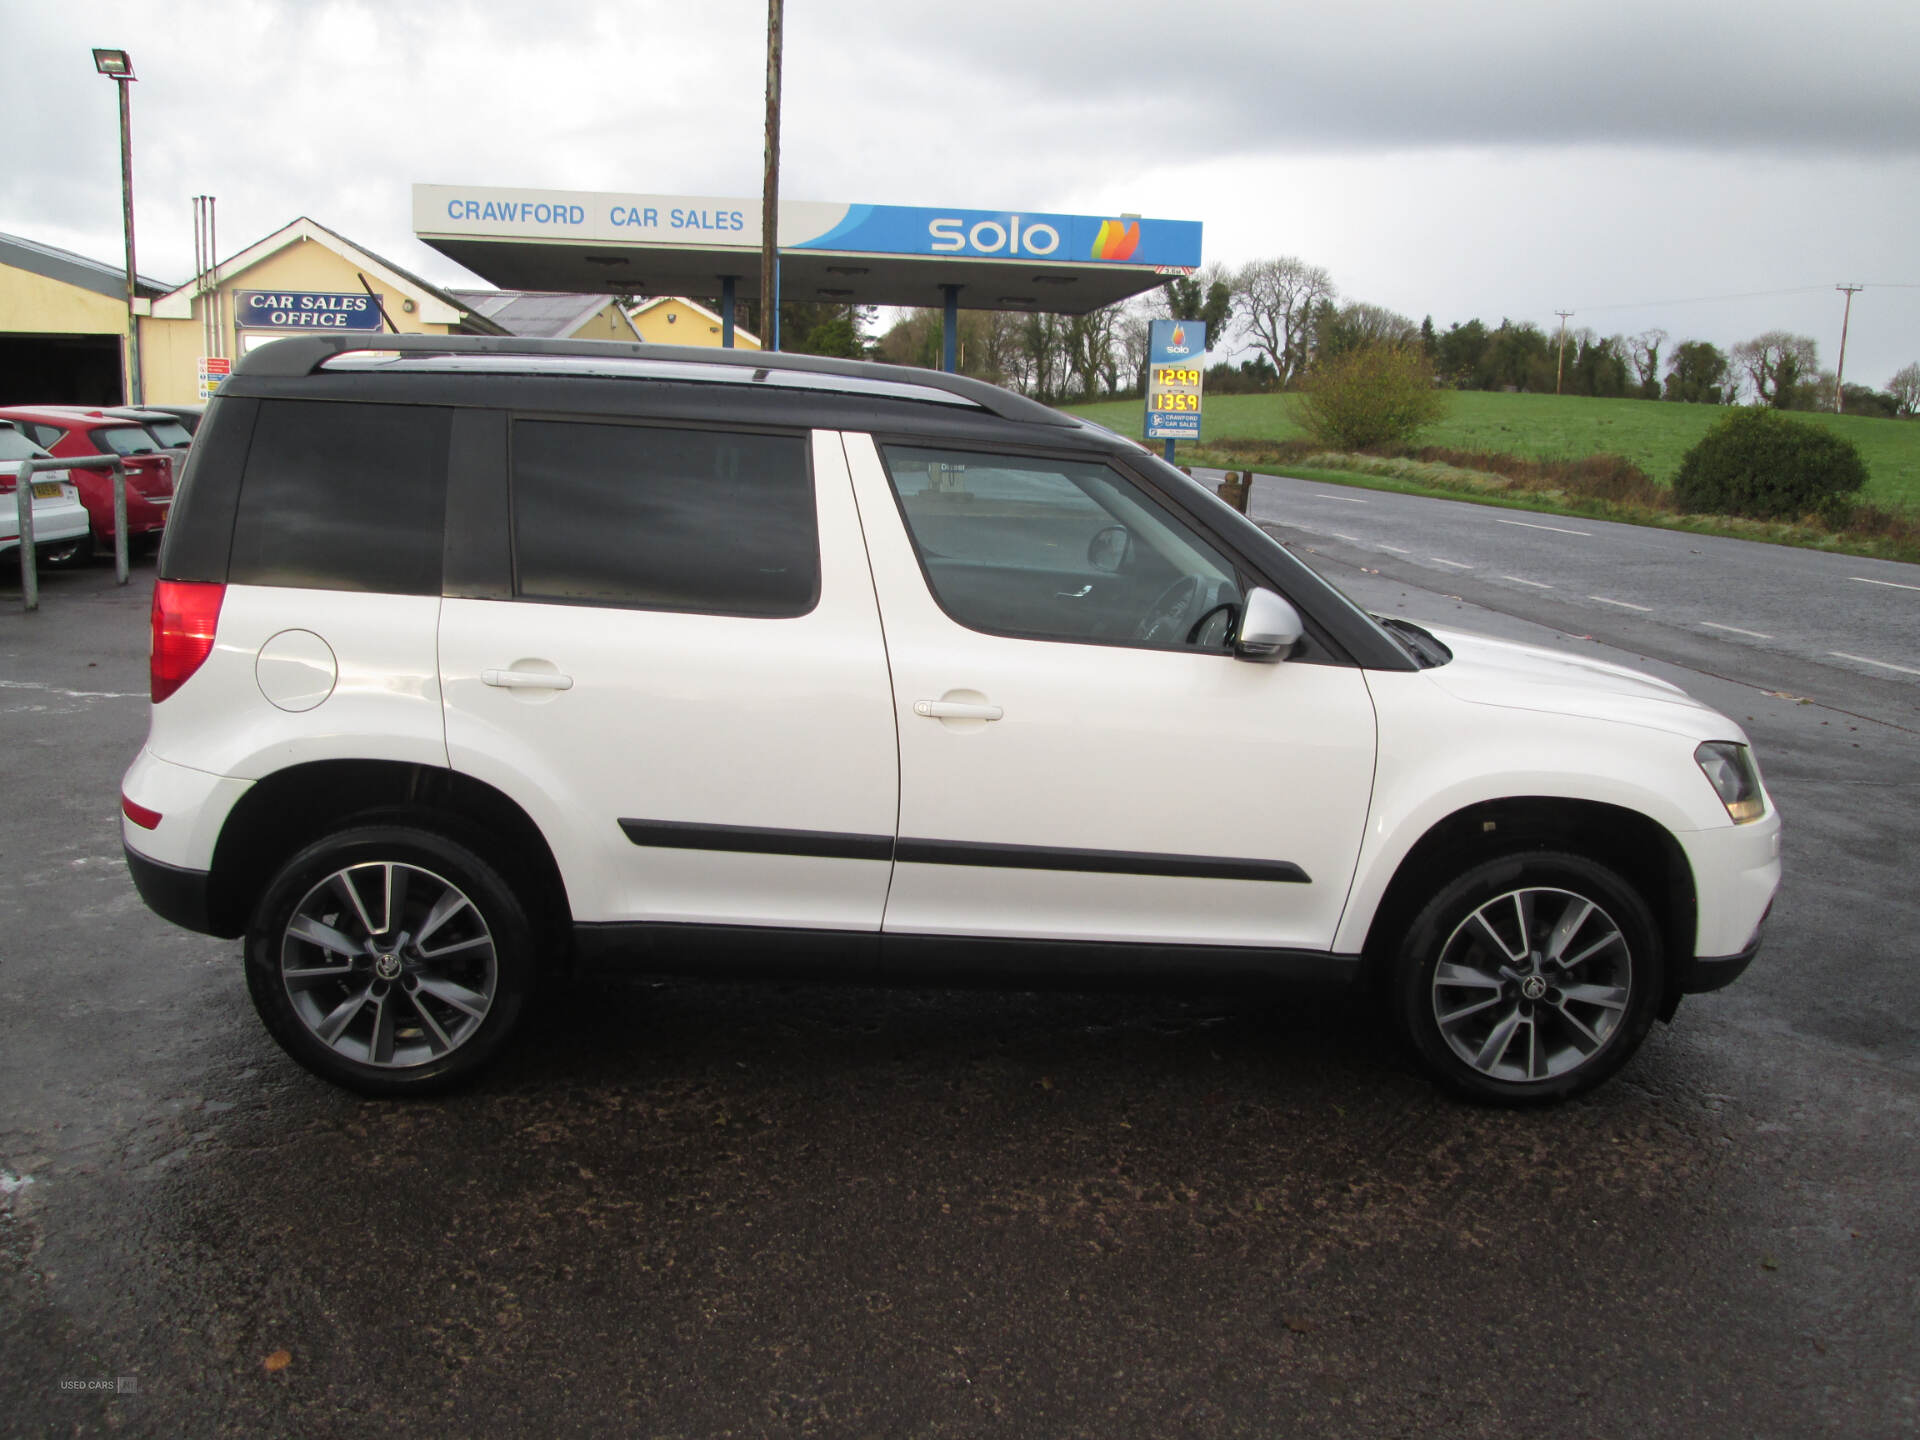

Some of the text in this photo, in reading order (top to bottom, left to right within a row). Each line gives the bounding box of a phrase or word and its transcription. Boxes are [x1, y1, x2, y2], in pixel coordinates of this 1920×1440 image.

[447, 200, 744, 231] CRAWFORD CAR SALES
[928, 215, 1060, 255] solo
[250, 295, 367, 311] CAR SALES
[271, 311, 348, 327] OFFICE
[1166, 346, 1189, 354] solo
